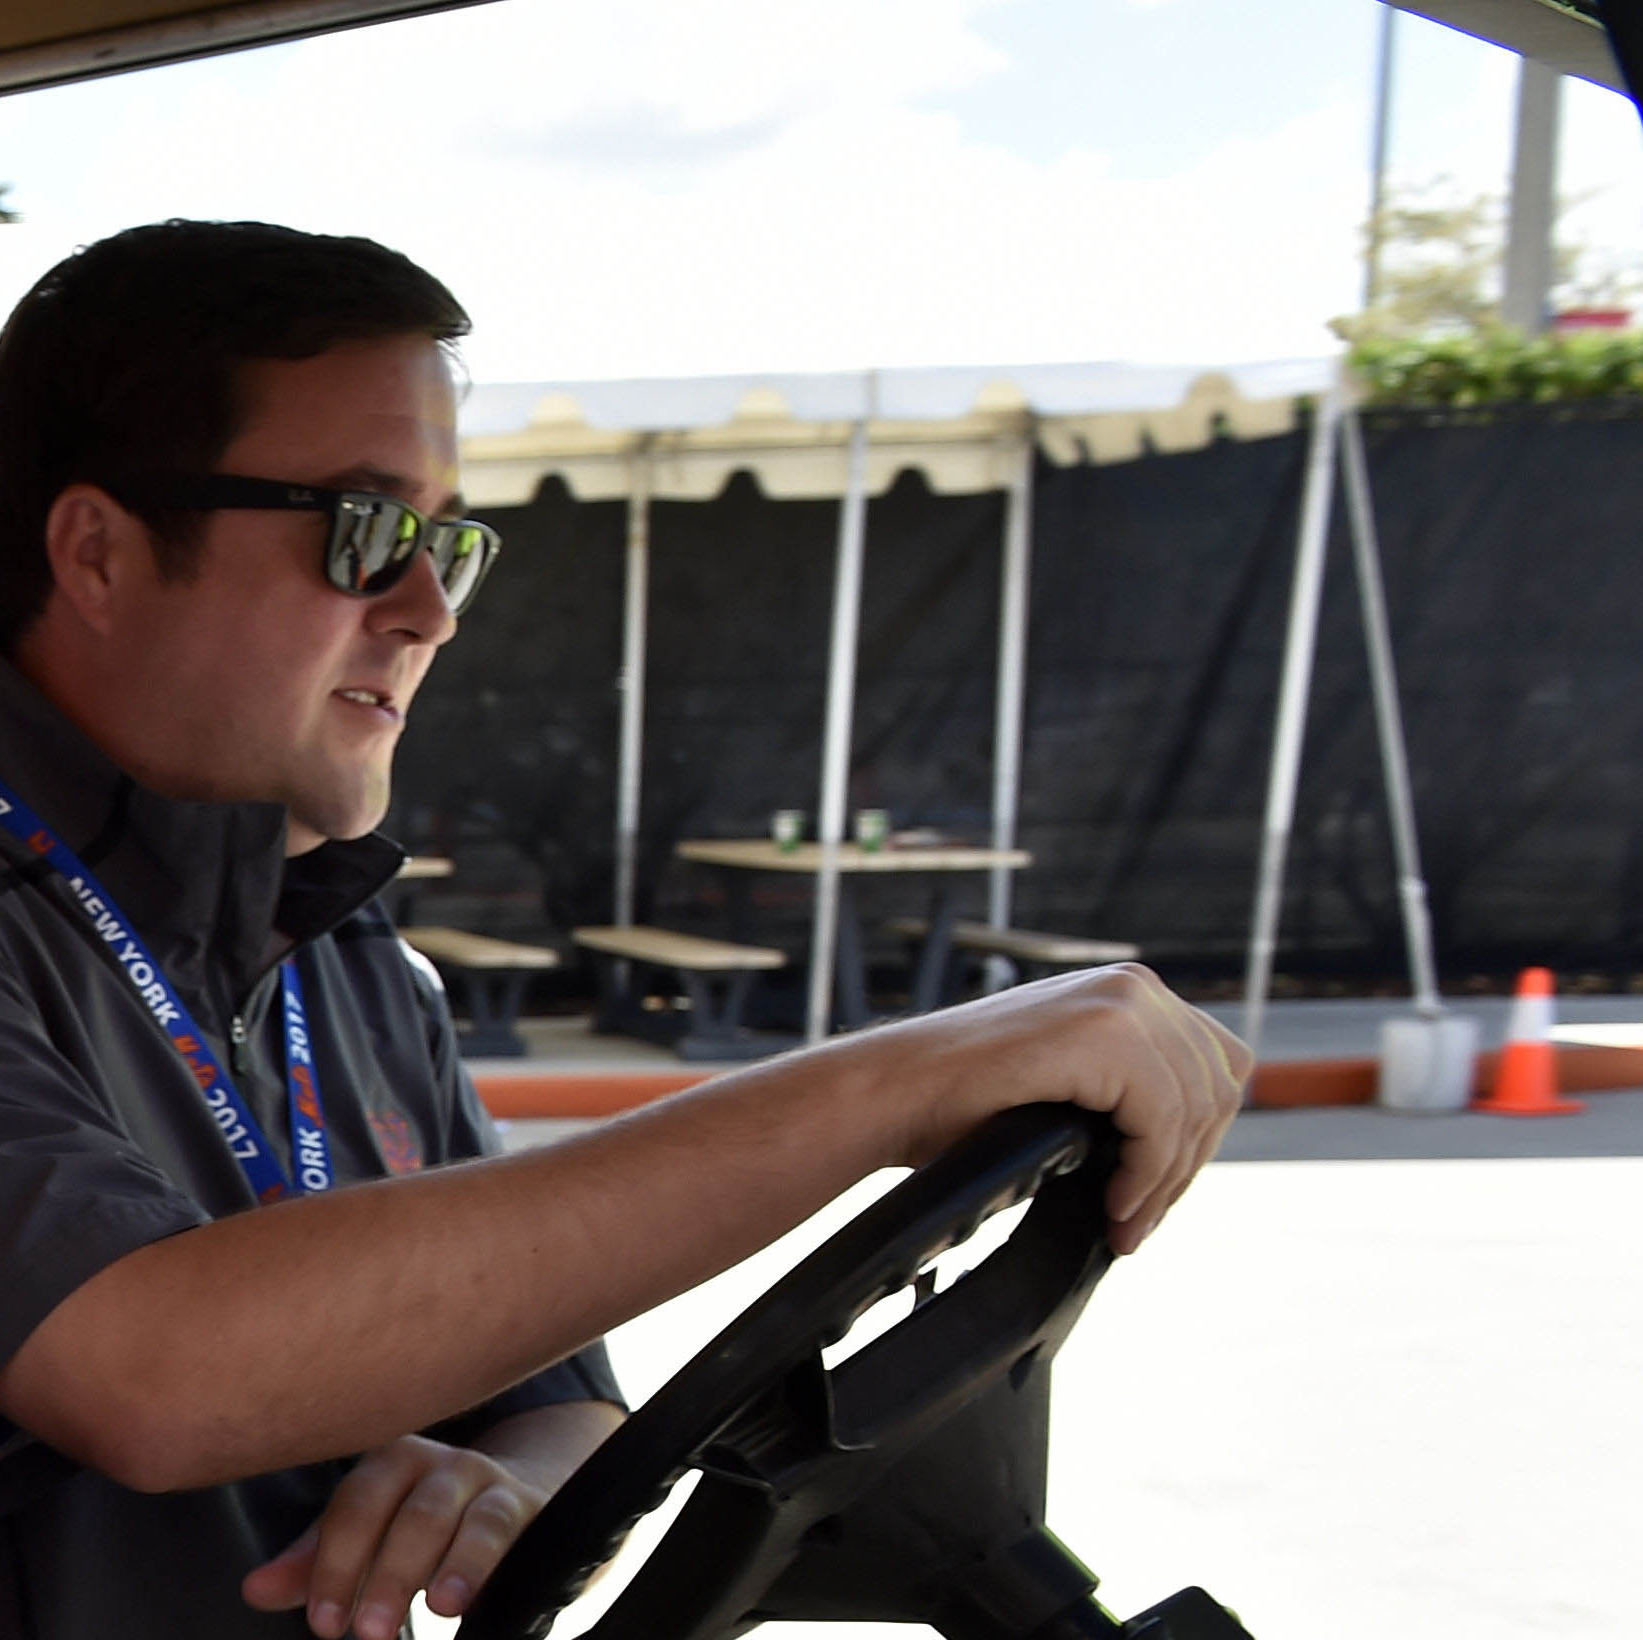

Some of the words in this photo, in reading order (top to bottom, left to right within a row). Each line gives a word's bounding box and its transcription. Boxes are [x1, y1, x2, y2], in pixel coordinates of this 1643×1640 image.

[70, 877, 127, 942] NEW
[118, 941, 181, 1027] YORK
[206, 1088, 260, 1161] 2017
[299, 1127, 330, 1193] ORK
